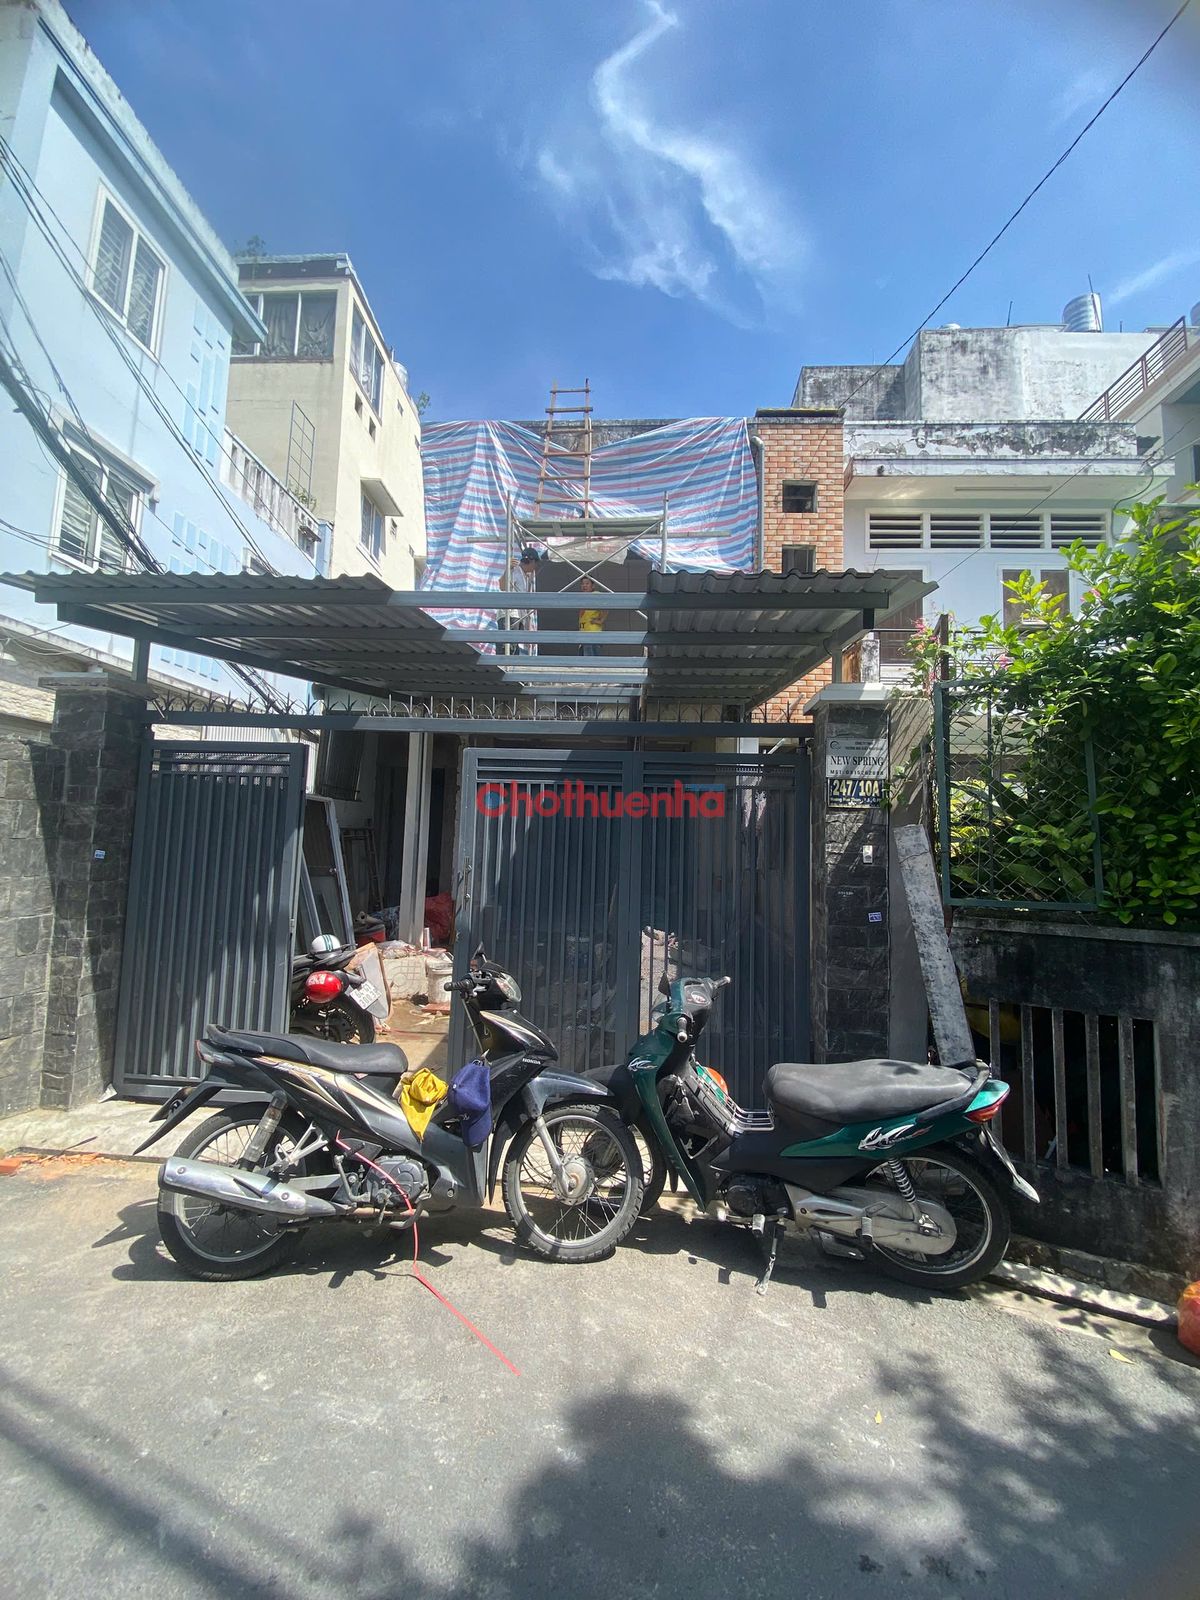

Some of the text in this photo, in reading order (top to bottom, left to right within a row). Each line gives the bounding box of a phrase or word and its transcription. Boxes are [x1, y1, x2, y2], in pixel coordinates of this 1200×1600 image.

[831, 756, 884, 766] NEW SPRING
[833, 780, 880, 797] 247/10A
